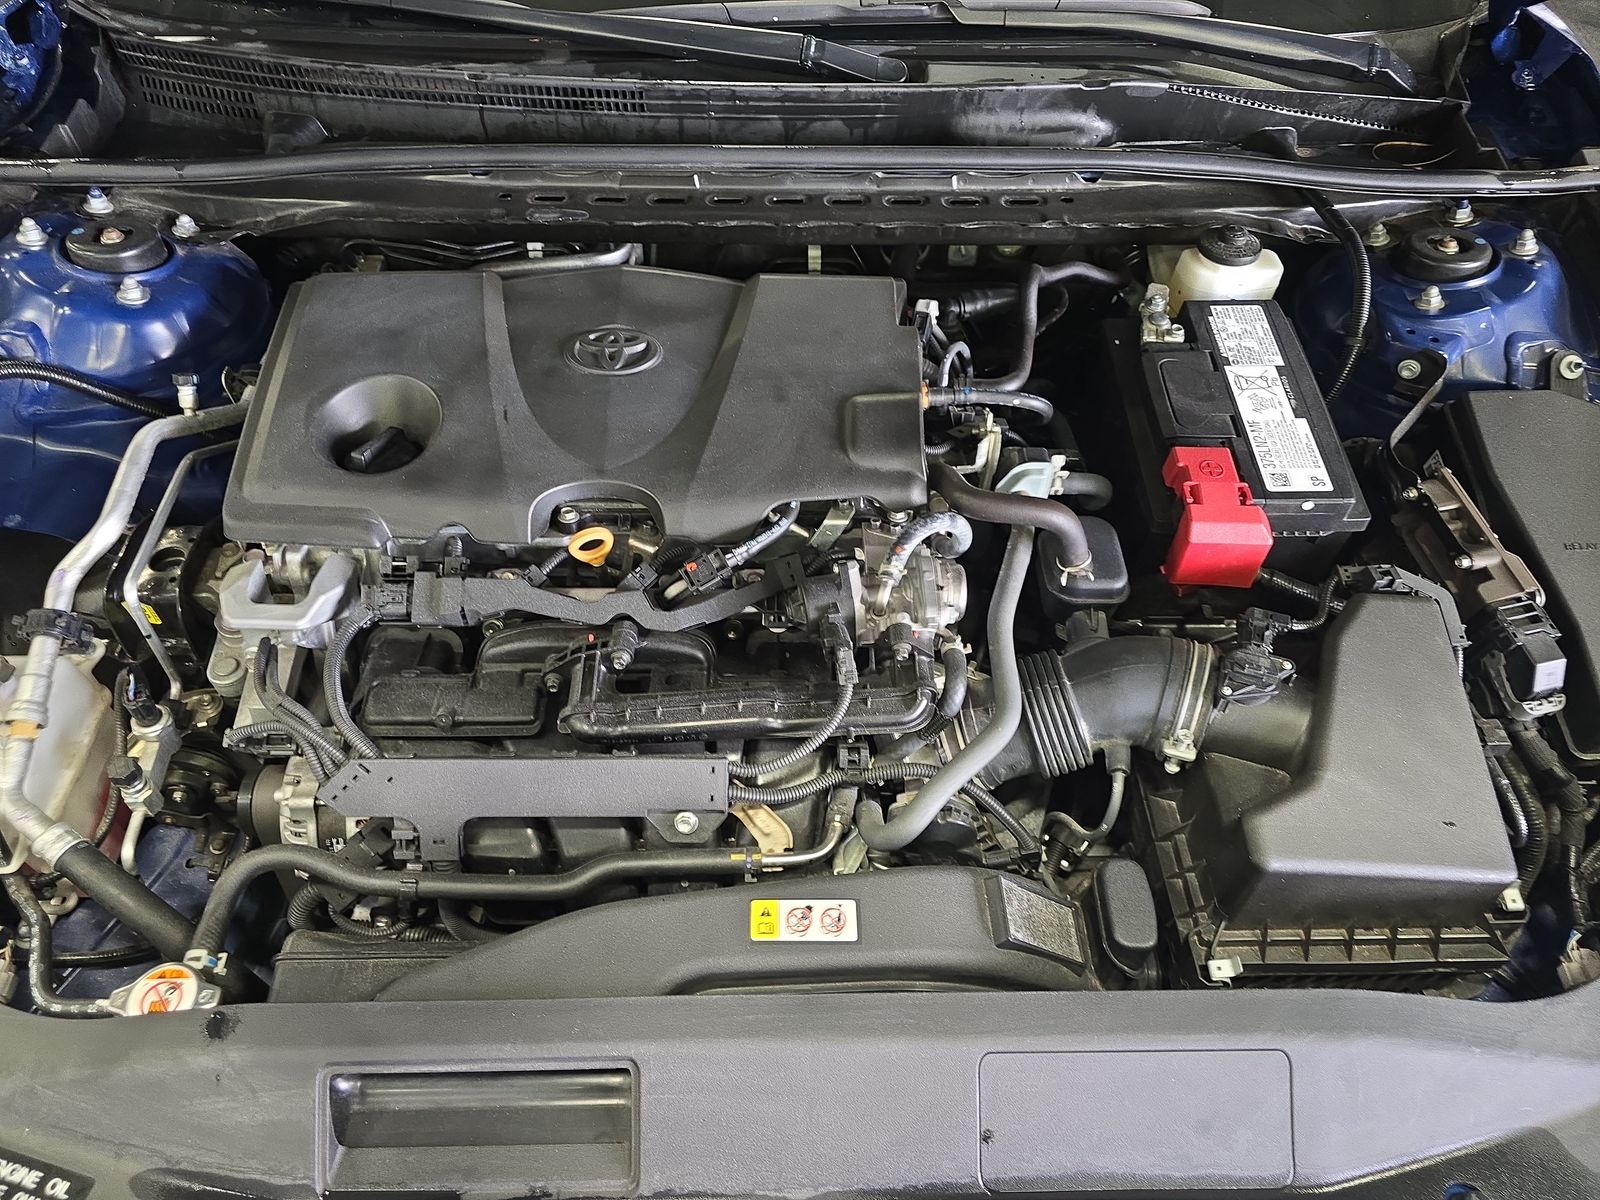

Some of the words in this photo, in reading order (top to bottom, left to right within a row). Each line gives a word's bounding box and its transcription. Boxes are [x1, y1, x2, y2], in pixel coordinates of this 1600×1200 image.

[1271, 377, 1281, 387] Pb
[1247, 420, 1276, 469] 375LN2-MF
[1310, 476, 1326, 487] SP
[1563, 542, 1597, 550] RELAY
[44, 1177, 71, 1200] OIL
